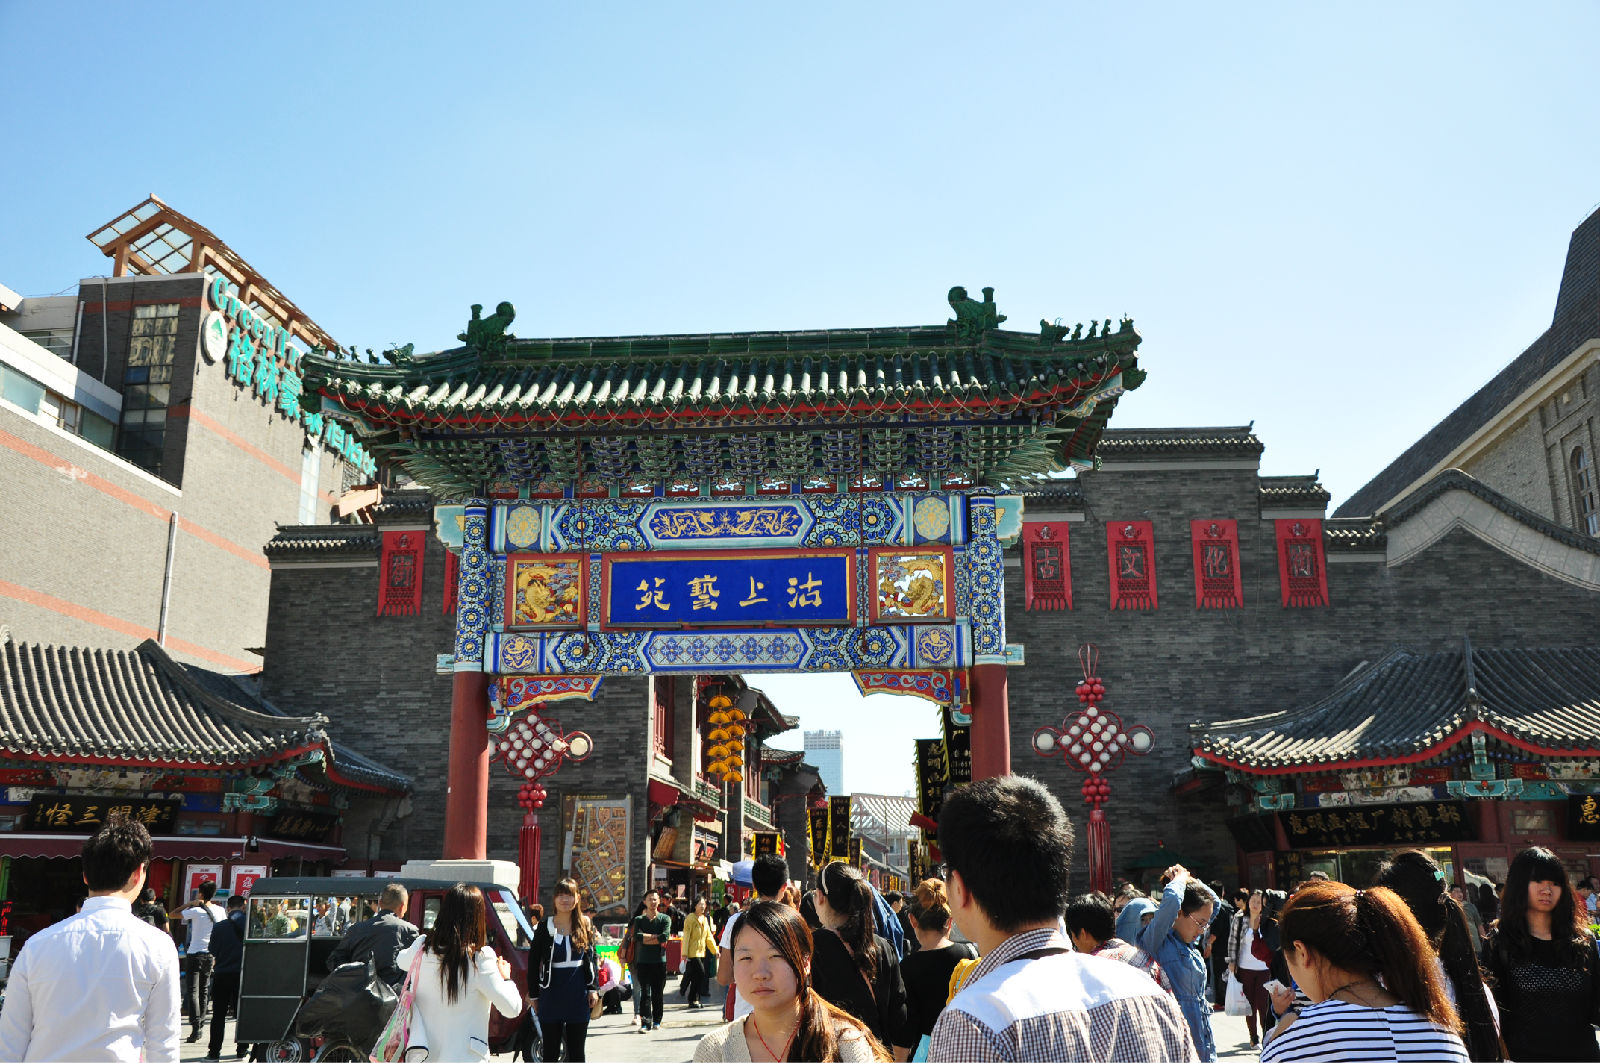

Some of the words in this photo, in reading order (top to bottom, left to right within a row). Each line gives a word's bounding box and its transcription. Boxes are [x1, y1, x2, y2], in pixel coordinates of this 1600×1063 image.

[1036, 548, 1058, 579] 古
[1121, 547, 1143, 578] 文
[1206, 545, 1229, 576] 化
[635, 571, 823, 611] 沽上藝苑
